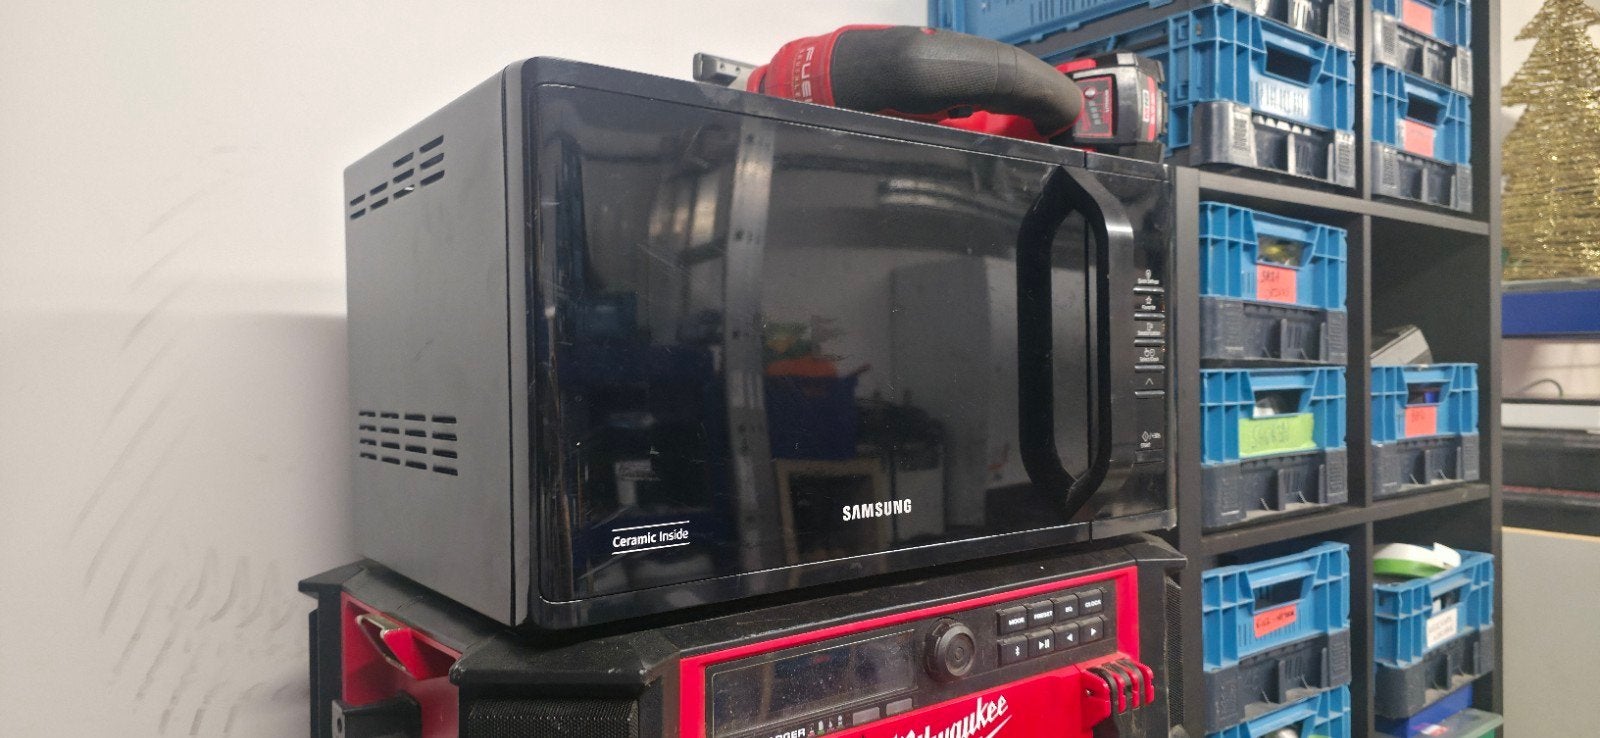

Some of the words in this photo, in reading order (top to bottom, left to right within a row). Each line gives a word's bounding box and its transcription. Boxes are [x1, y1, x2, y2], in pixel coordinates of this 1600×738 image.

[842, 498, 912, 522] SAMSUNG
[612, 531, 657, 548] Ceramic
[659, 528, 689, 542] Inside
[1084, 599, 1102, 608] CLOCK
[1008, 617, 1025, 626] MODE
[1033, 610, 1053, 620] PRESET
[894, 694, 1009, 738] aukee
